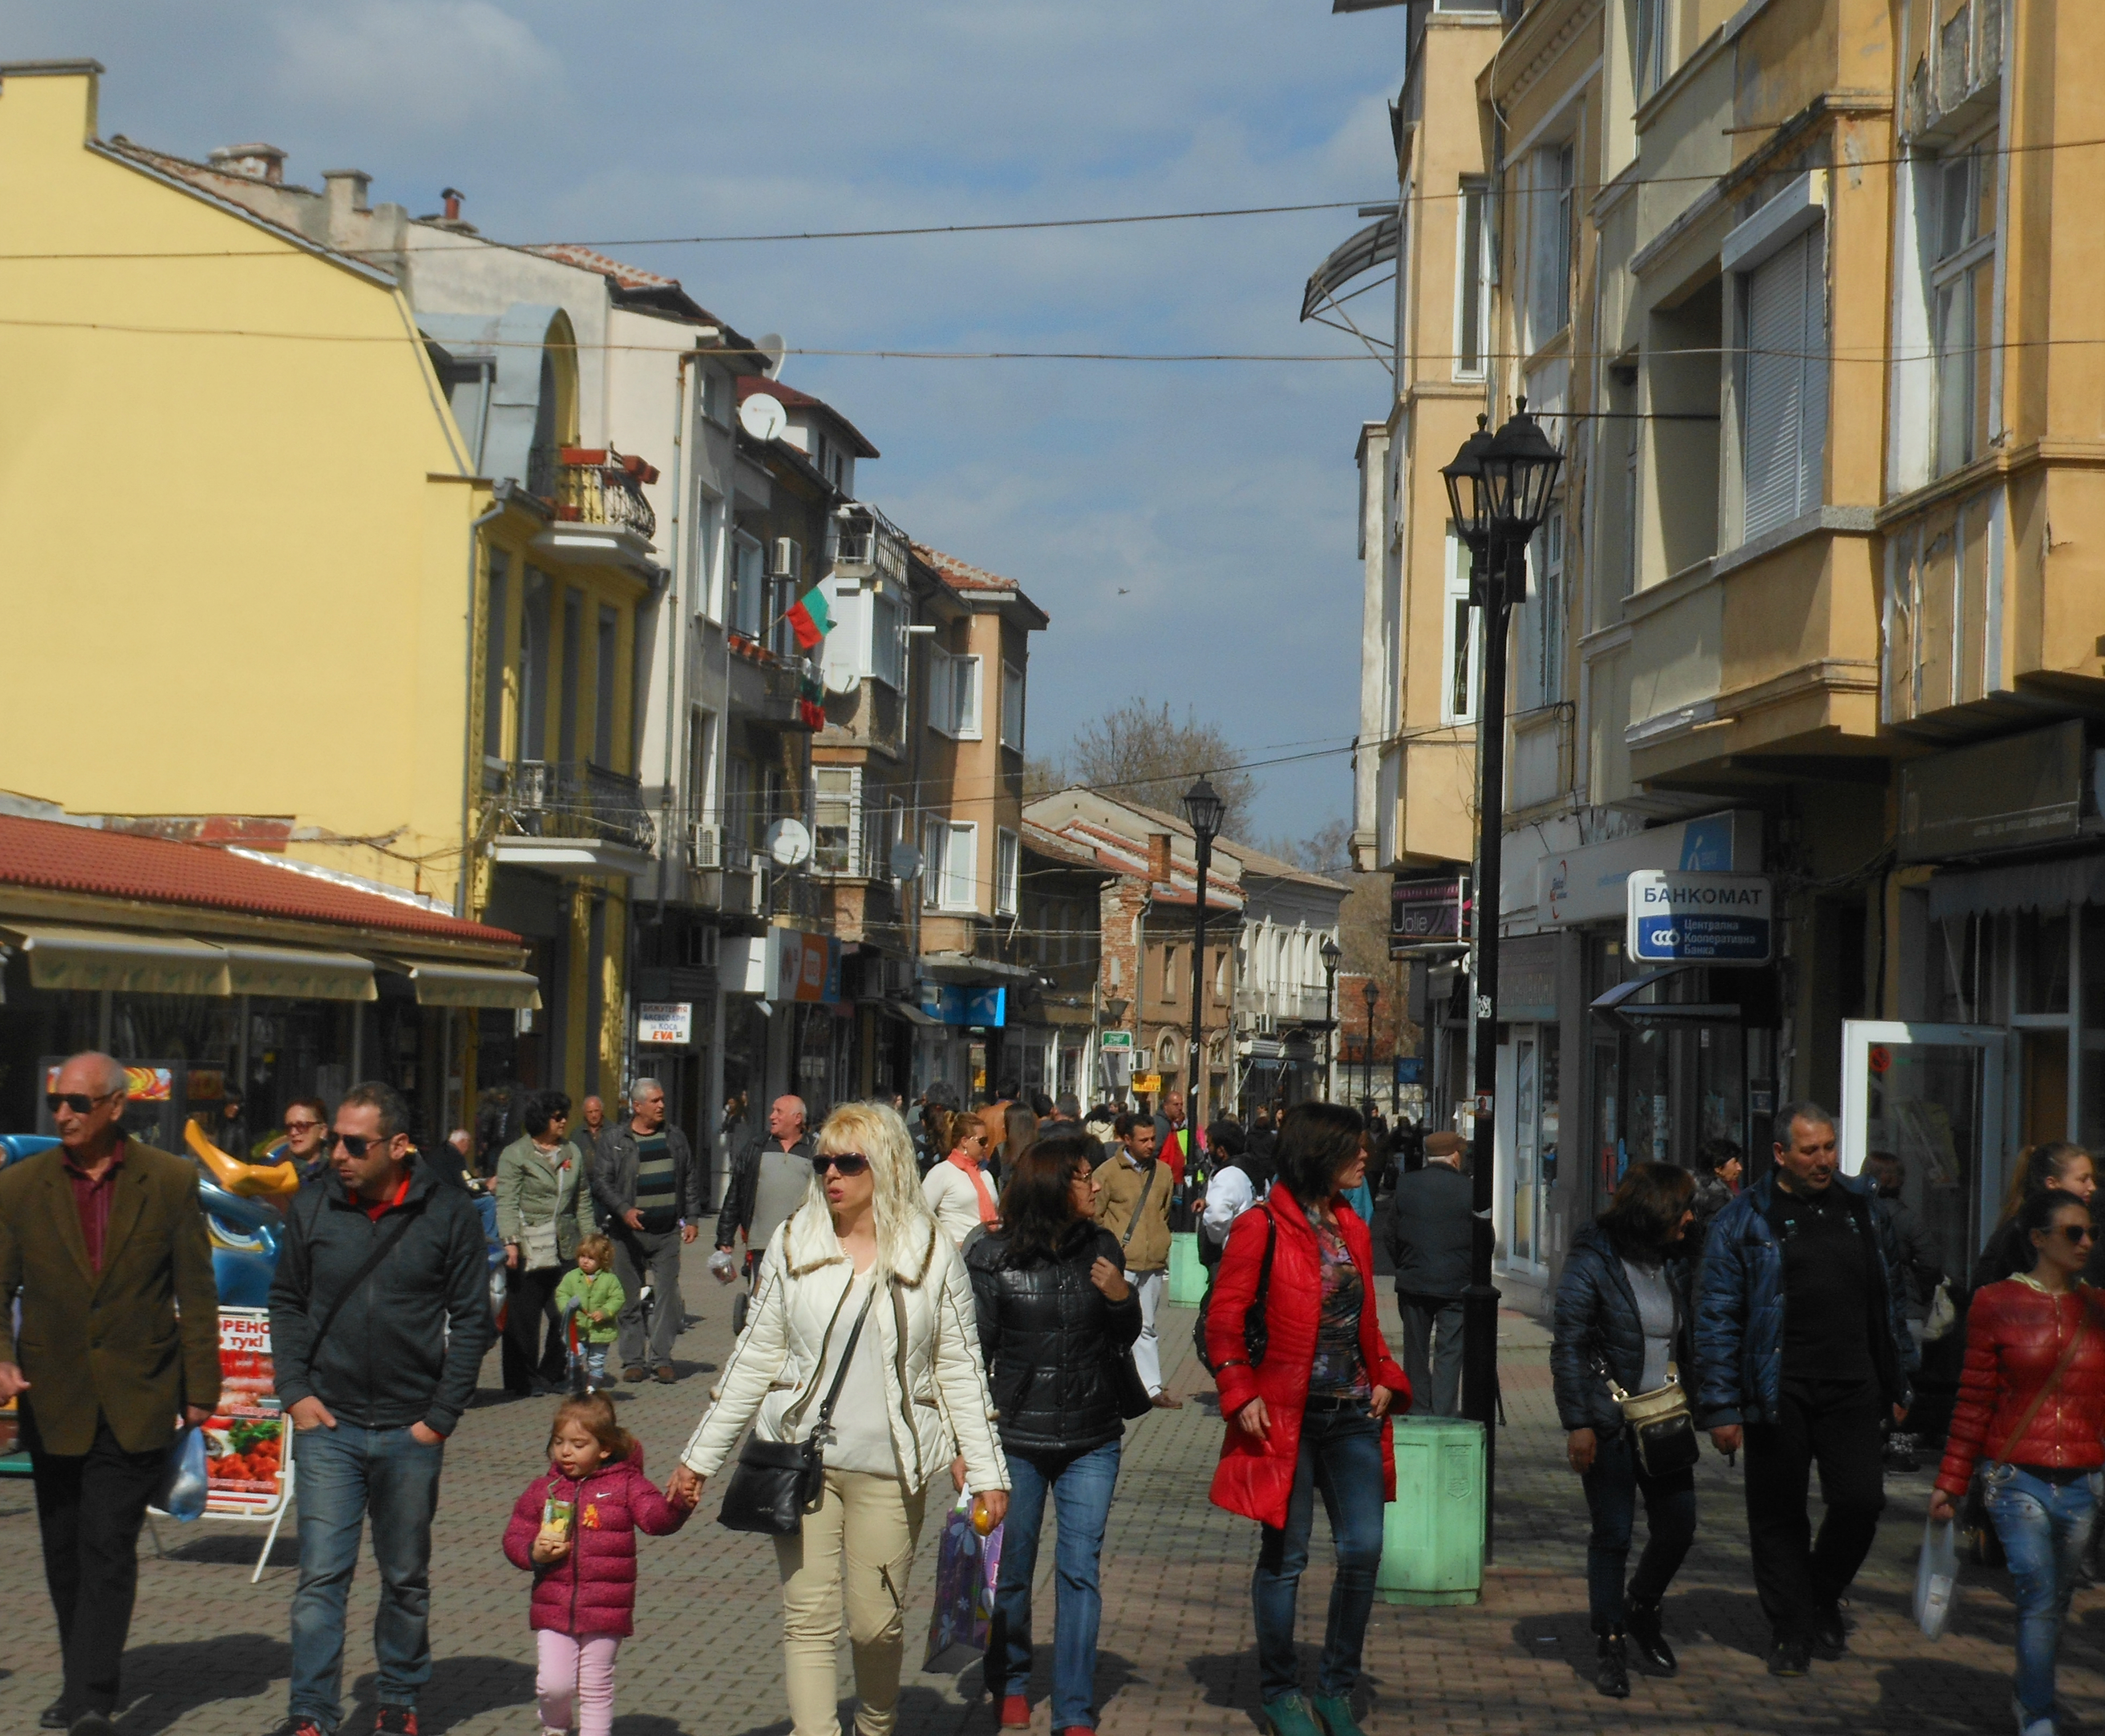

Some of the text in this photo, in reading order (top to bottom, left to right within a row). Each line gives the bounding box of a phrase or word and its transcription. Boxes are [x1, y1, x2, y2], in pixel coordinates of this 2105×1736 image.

[1644, 887, 1763, 904] БАНКОМАТ
[1393, 902, 1427, 932] Jolie
[1684, 919, 1739, 930] Централна
[1684, 933, 1756, 944] Кооперативна
[1684, 944, 1715, 955] Банка
[652, 1031, 673, 1040] EVA
[230, 1335, 263, 1349] тук!
